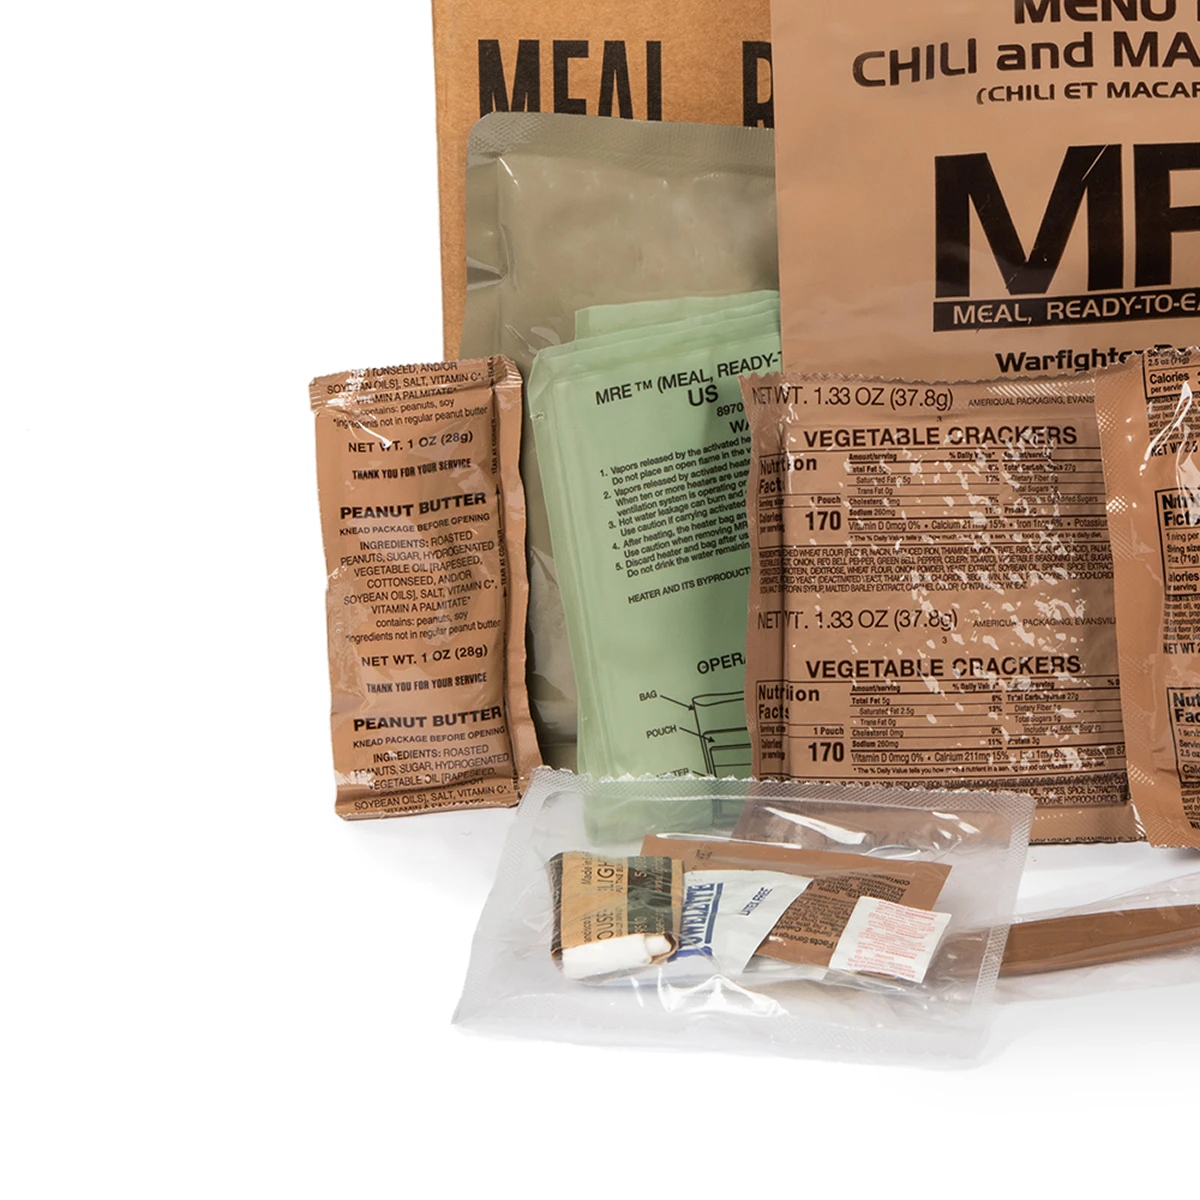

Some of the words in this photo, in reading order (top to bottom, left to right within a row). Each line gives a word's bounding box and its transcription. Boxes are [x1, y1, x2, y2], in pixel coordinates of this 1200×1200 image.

[852, 38, 978, 88] CHILI
[997, 31, 1095, 72] and
[976, 82, 1056, 105] (CHILI
[1063, 82, 1099, 100] ET
[952, 302, 1034, 326] MEAL,
[596, 382, 632, 406] MRE
[656, 368, 714, 394] (MEAL,
[687, 384, 720, 407] US
[813, 386, 851, 406] 1.33
[855, 386, 886, 407] OZ
[889, 387, 954, 412] (37.8g)
[349, 442, 374, 454] NET
[407, 439, 414, 450] 1
[418, 435, 437, 448] OZ
[441, 430, 474, 446] (28g)
[803, 426, 941, 448] VEGETABLE
[949, 425, 1078, 445] CRACKERS
[353, 469, 379, 480] THANK
[382, 467, 398, 479] YOU
[400, 466, 415, 478] FOR
[417, 463, 438, 476] YOUR
[438, 458, 472, 471] SERVICE
[340, 503, 414, 520] PEANUT
[419, 491, 487, 515] BUTTER
[804, 511, 842, 532] 170
[627, 588, 661, 605] HEATER
[662, 583, 681, 596] AND
[681, 579, 696, 591] ITS
[814, 610, 855, 630] 1.33
[858, 610, 889, 629] OZ
[893, 608, 959, 633] (37.8g)
[361, 655, 388, 667] NET
[393, 653, 417, 667] WT.
[421, 652, 428, 663] 1
[432, 648, 452, 661] OZ
[454, 645, 489, 661] (28g)
[805, 659, 945, 679] VEGETABLE
[951, 655, 1082, 678] CRACKERS
[638, 689, 658, 702] BAG
[353, 715, 428, 732] PEANUT
[432, 705, 503, 727] BUTTER
[646, 724, 678, 739] POUCH
[807, 741, 846, 762] 170
